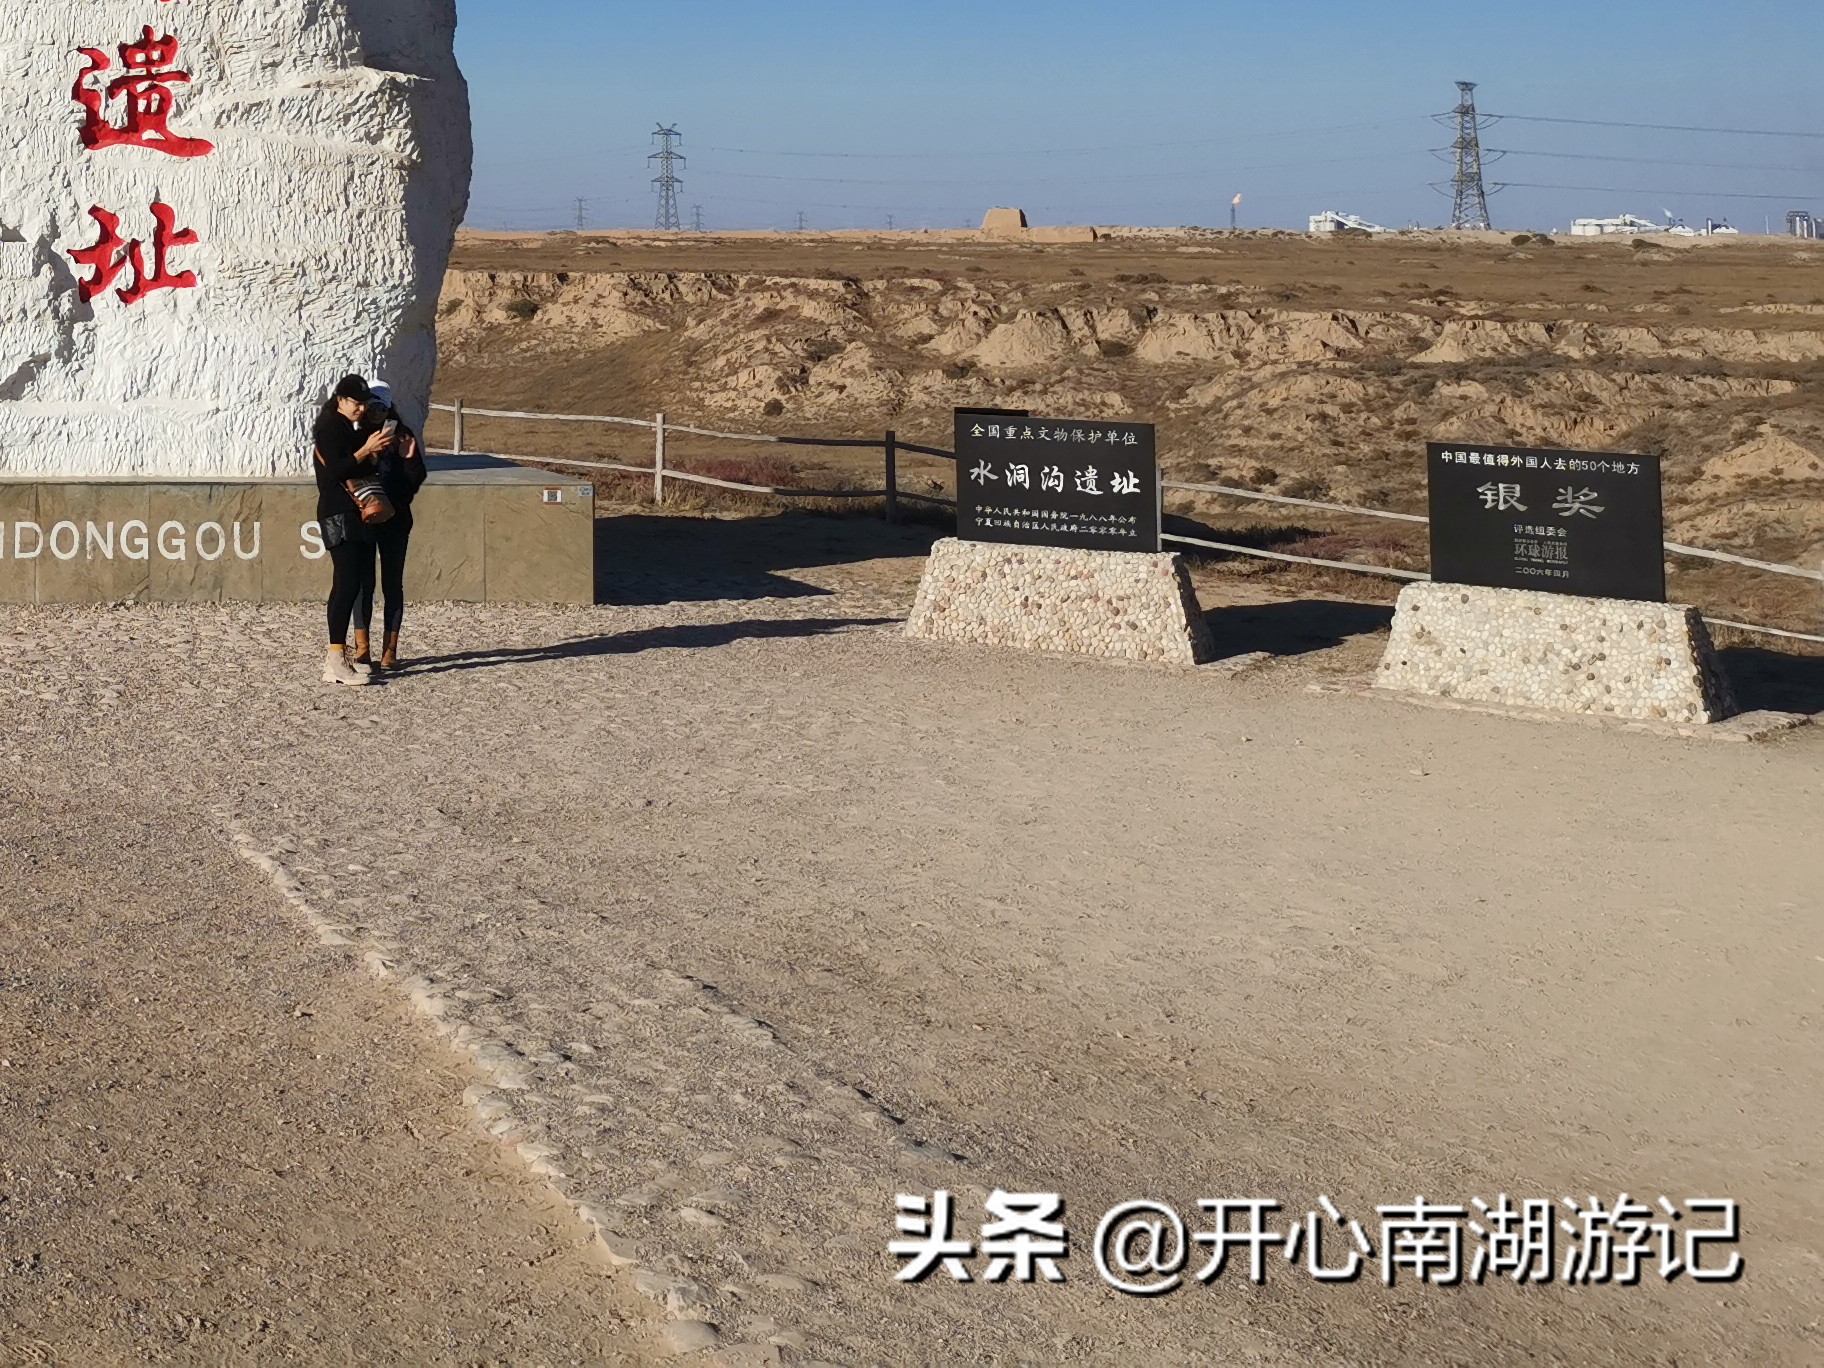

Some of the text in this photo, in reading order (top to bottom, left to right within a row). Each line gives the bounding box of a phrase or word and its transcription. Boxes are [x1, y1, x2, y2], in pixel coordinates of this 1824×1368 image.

[969, 422, 1139, 446] 全国重点文物保护单位
[1441, 450, 1641, 475] 中国最值得外国人去的50个地方
[969, 458, 1142, 496] 水洞沟遗址
[975, 504, 1138, 524] 中华人民共和国国务院一九八八年公布
[1513, 523, 1568, 537] 评选组委会
[1513, 543, 1569, 560] 环球游报
